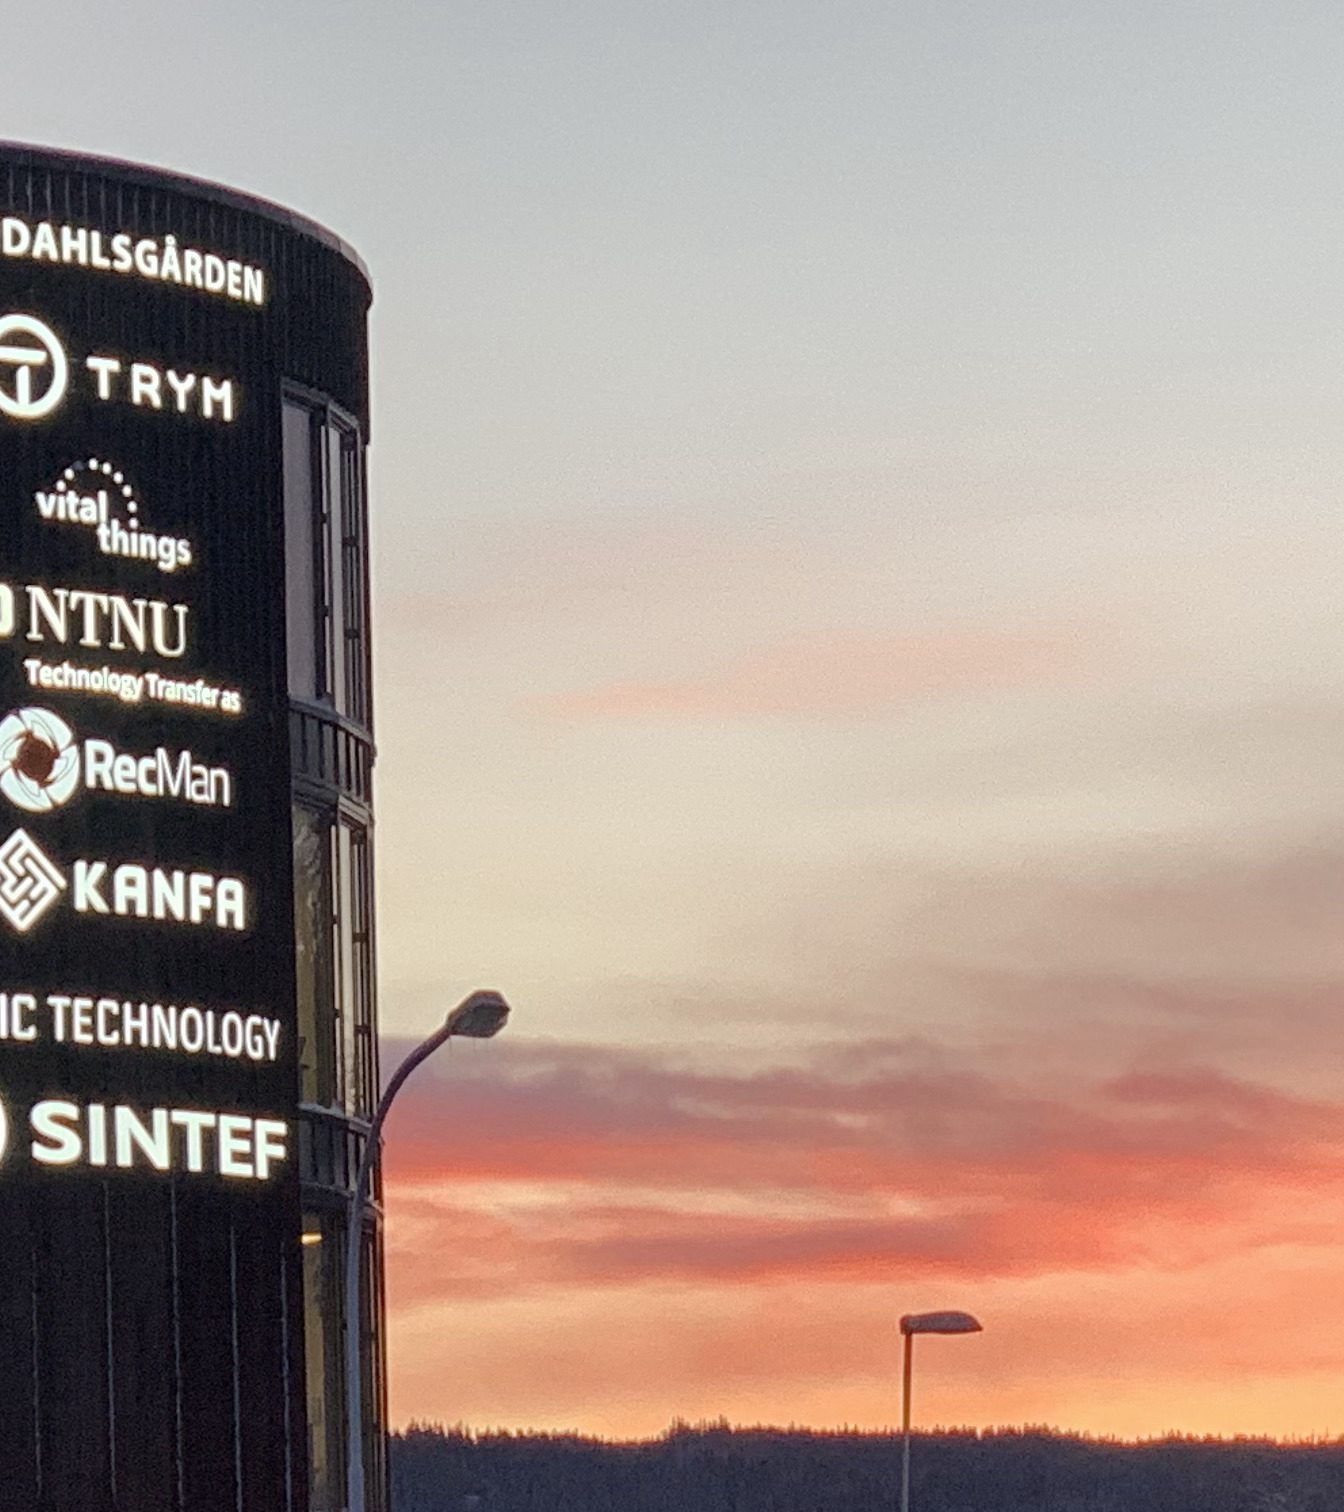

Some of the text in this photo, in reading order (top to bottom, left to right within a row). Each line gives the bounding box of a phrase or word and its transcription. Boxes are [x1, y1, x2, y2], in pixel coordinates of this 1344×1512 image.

[86, 356, 234, 422] TRYM
[35, 489, 108, 525] vital
[96, 519, 193, 573] things
[24, 585, 189, 659] NTNU
[23, 658, 143, 702] Technology
[144, 672, 219, 707] Transfer
[84, 739, 232, 807] RecMan
[73, 859, 246, 931] KANFA
[46, 994, 282, 1061] TECHNOLOGY
[30, 1100, 289, 1180] SINTEF
